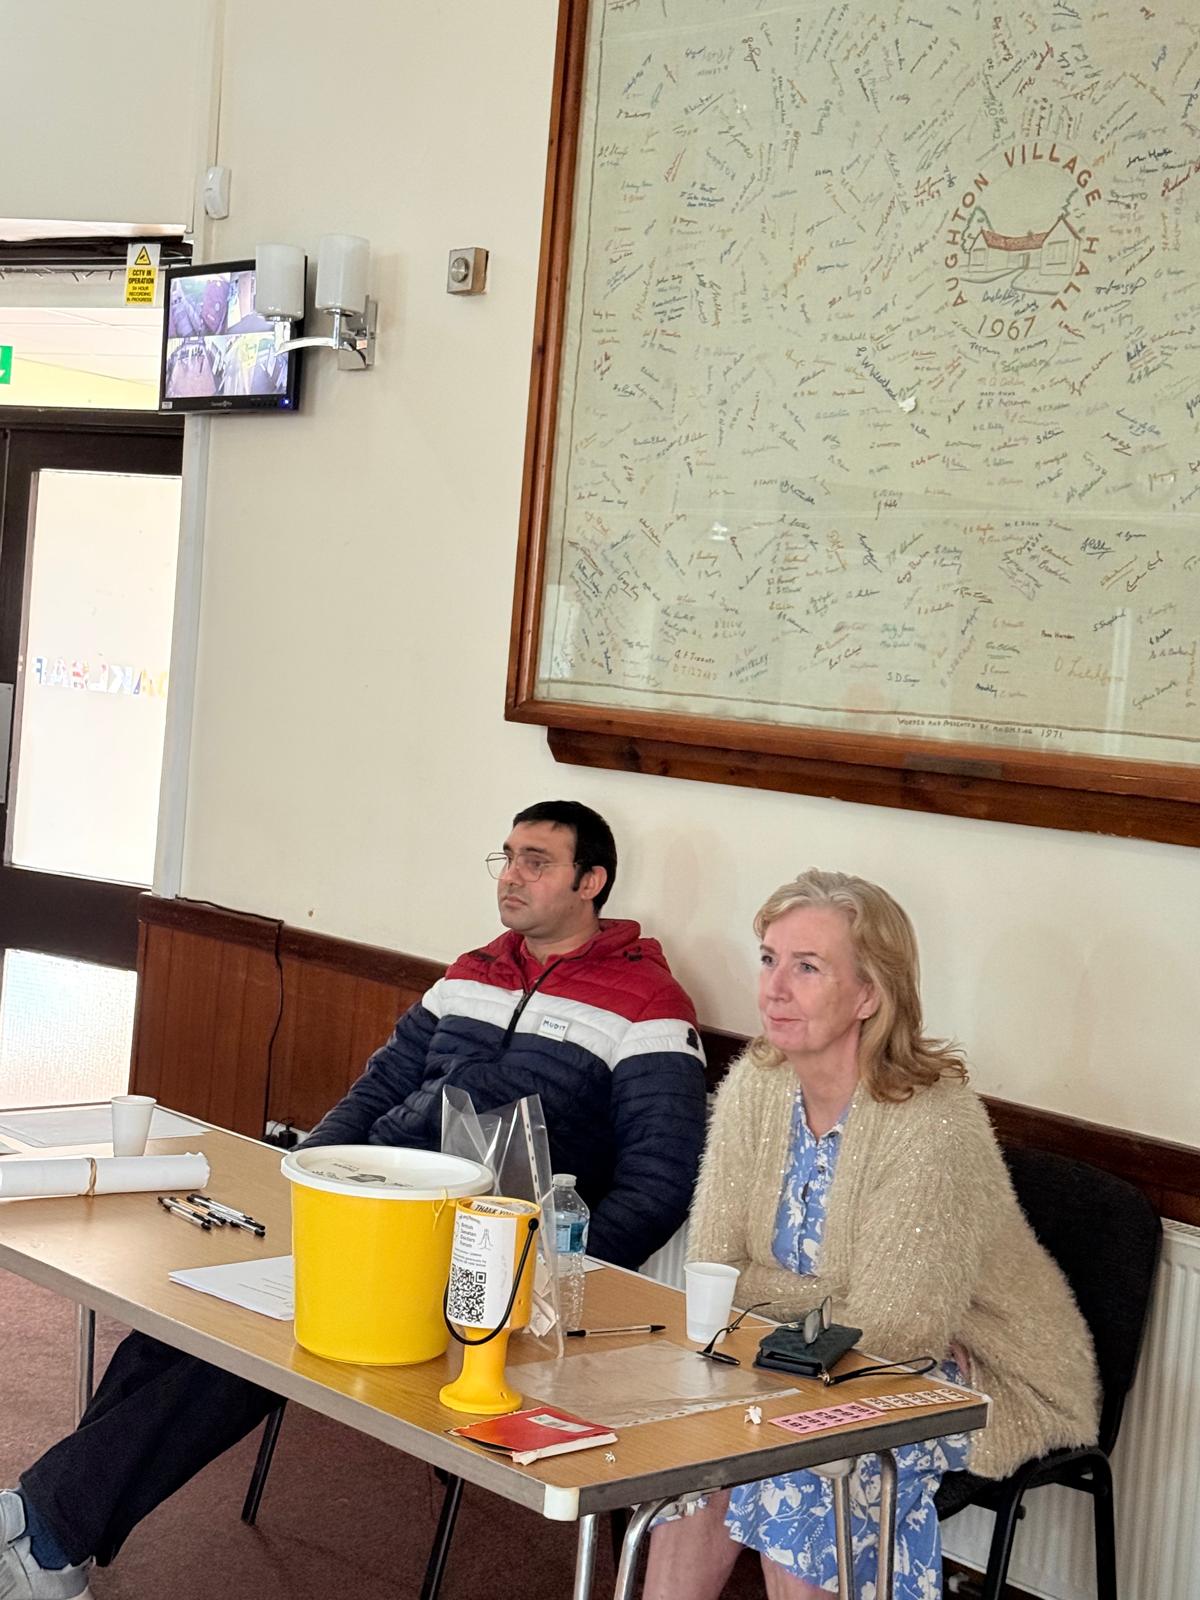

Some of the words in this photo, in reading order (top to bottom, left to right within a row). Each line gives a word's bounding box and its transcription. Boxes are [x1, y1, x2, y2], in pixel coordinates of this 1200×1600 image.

[1004, 142, 1101, 207] VILLAGE
[944, 173, 989, 307] AUGHTON
[1050, 236, 1099, 311] HALL
[978, 315, 1036, 340] 1967
[1040, 729, 1064, 739] 1971
[543, 1019, 566, 1031] MUDIT
[475, 1205, 498, 1214] THANK
